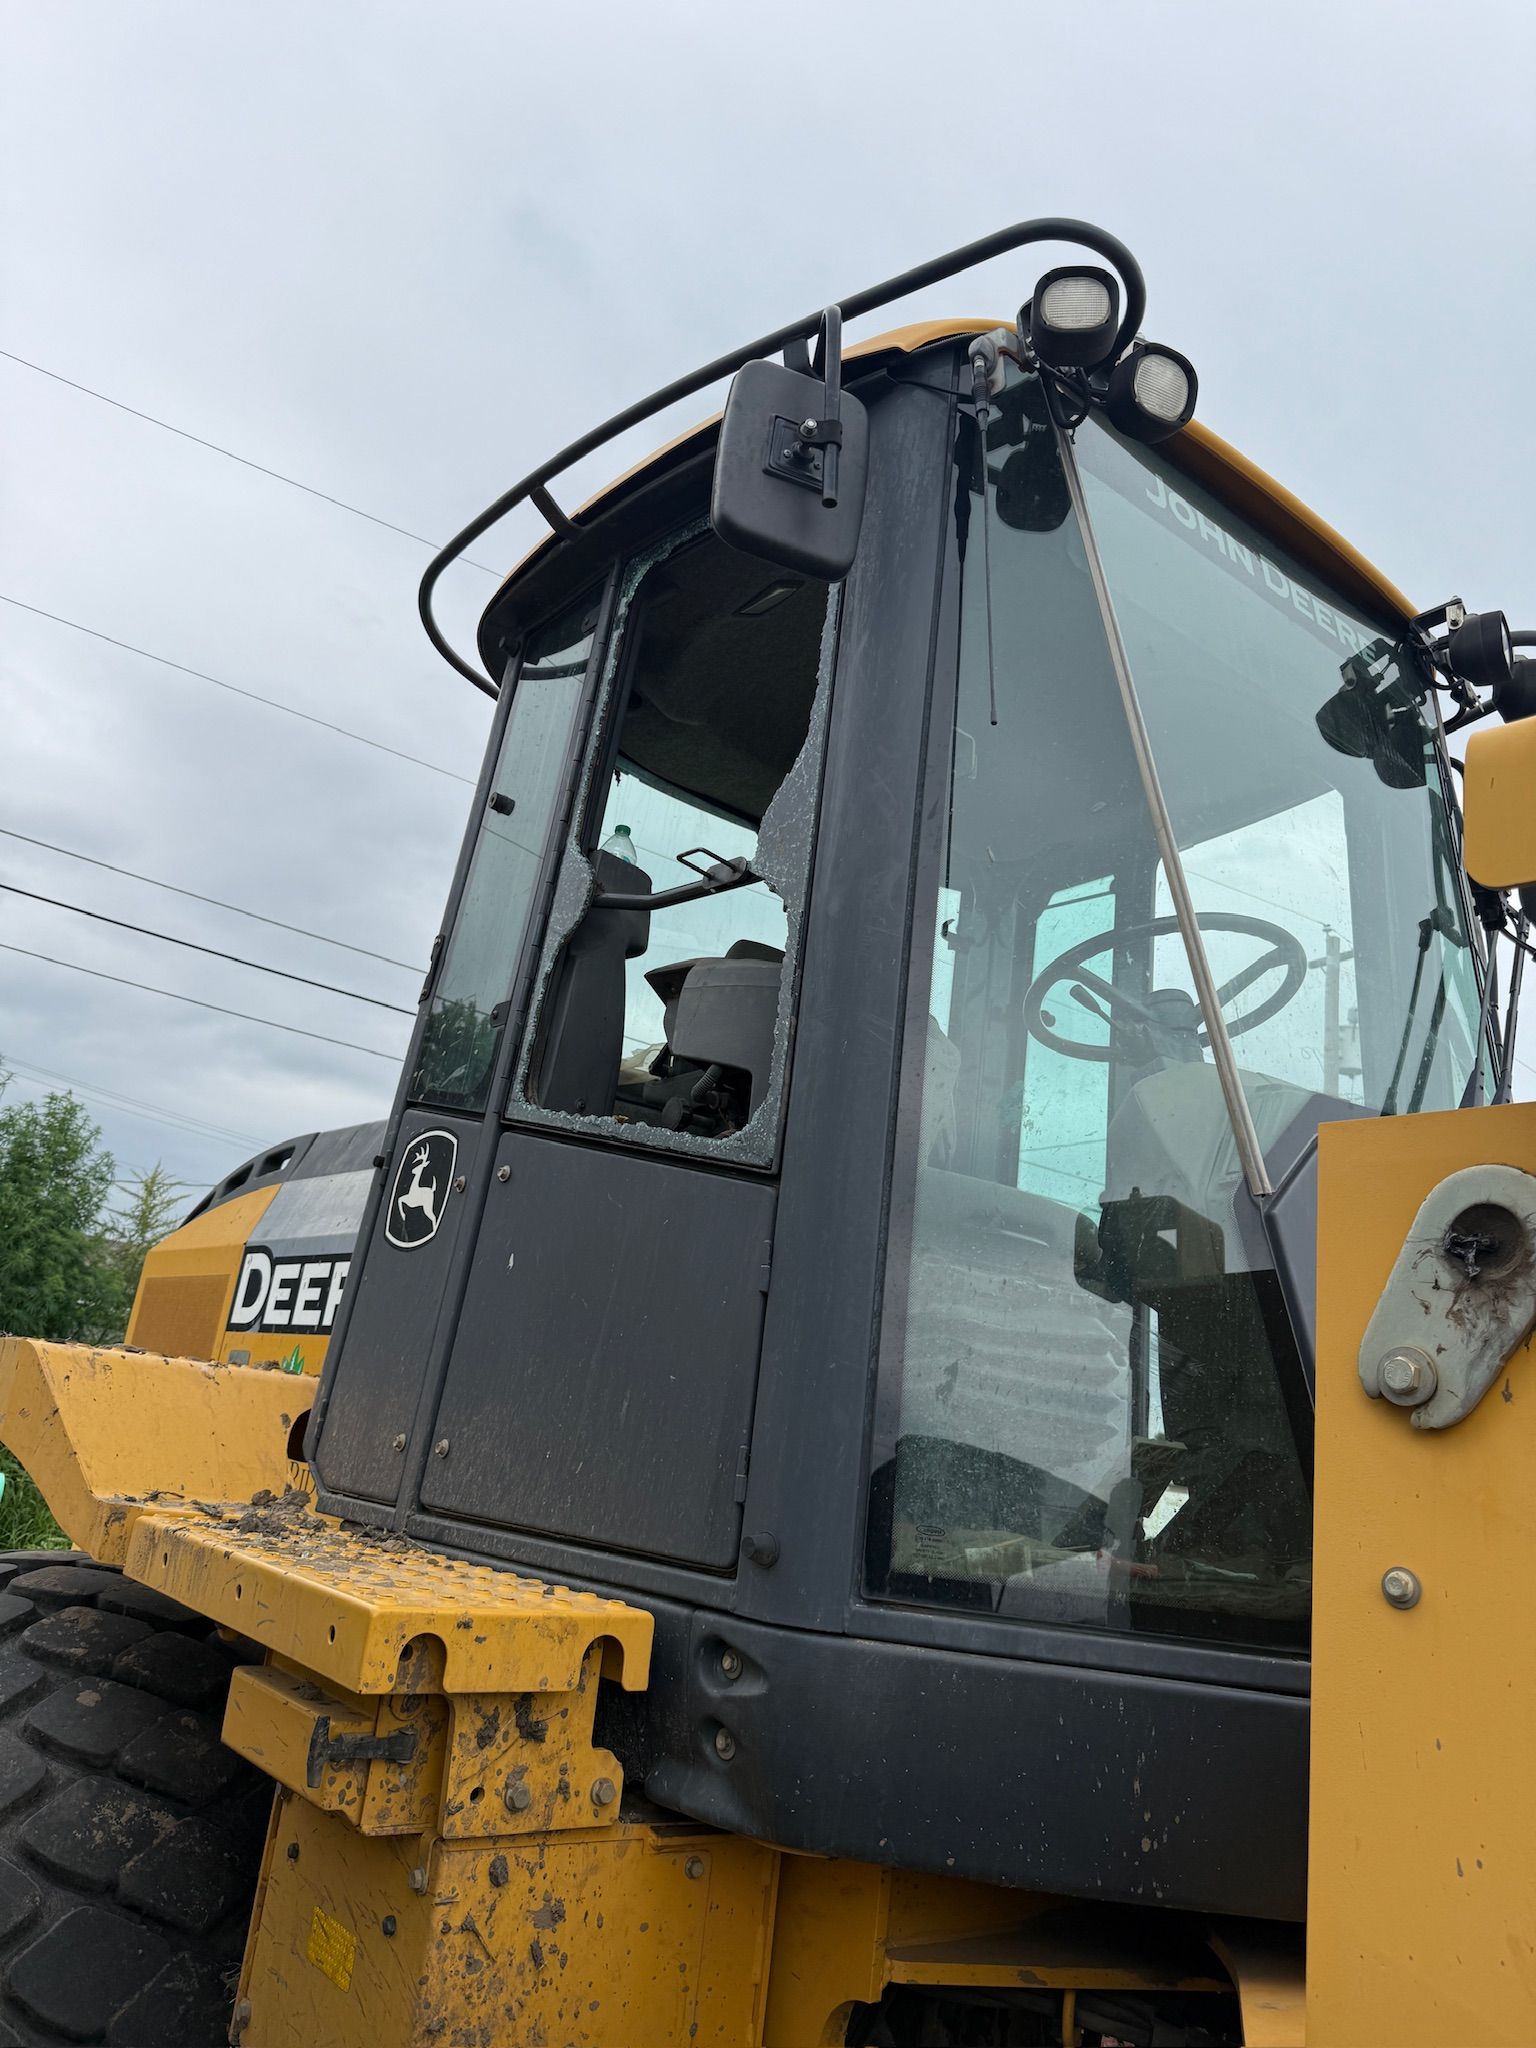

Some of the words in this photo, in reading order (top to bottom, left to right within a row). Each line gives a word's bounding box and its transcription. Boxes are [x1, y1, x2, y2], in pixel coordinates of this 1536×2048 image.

[1145, 474, 1255, 576] JOHN
[1260, 556, 1377, 665] DEERE
[230, 1253, 351, 1327] DEER
